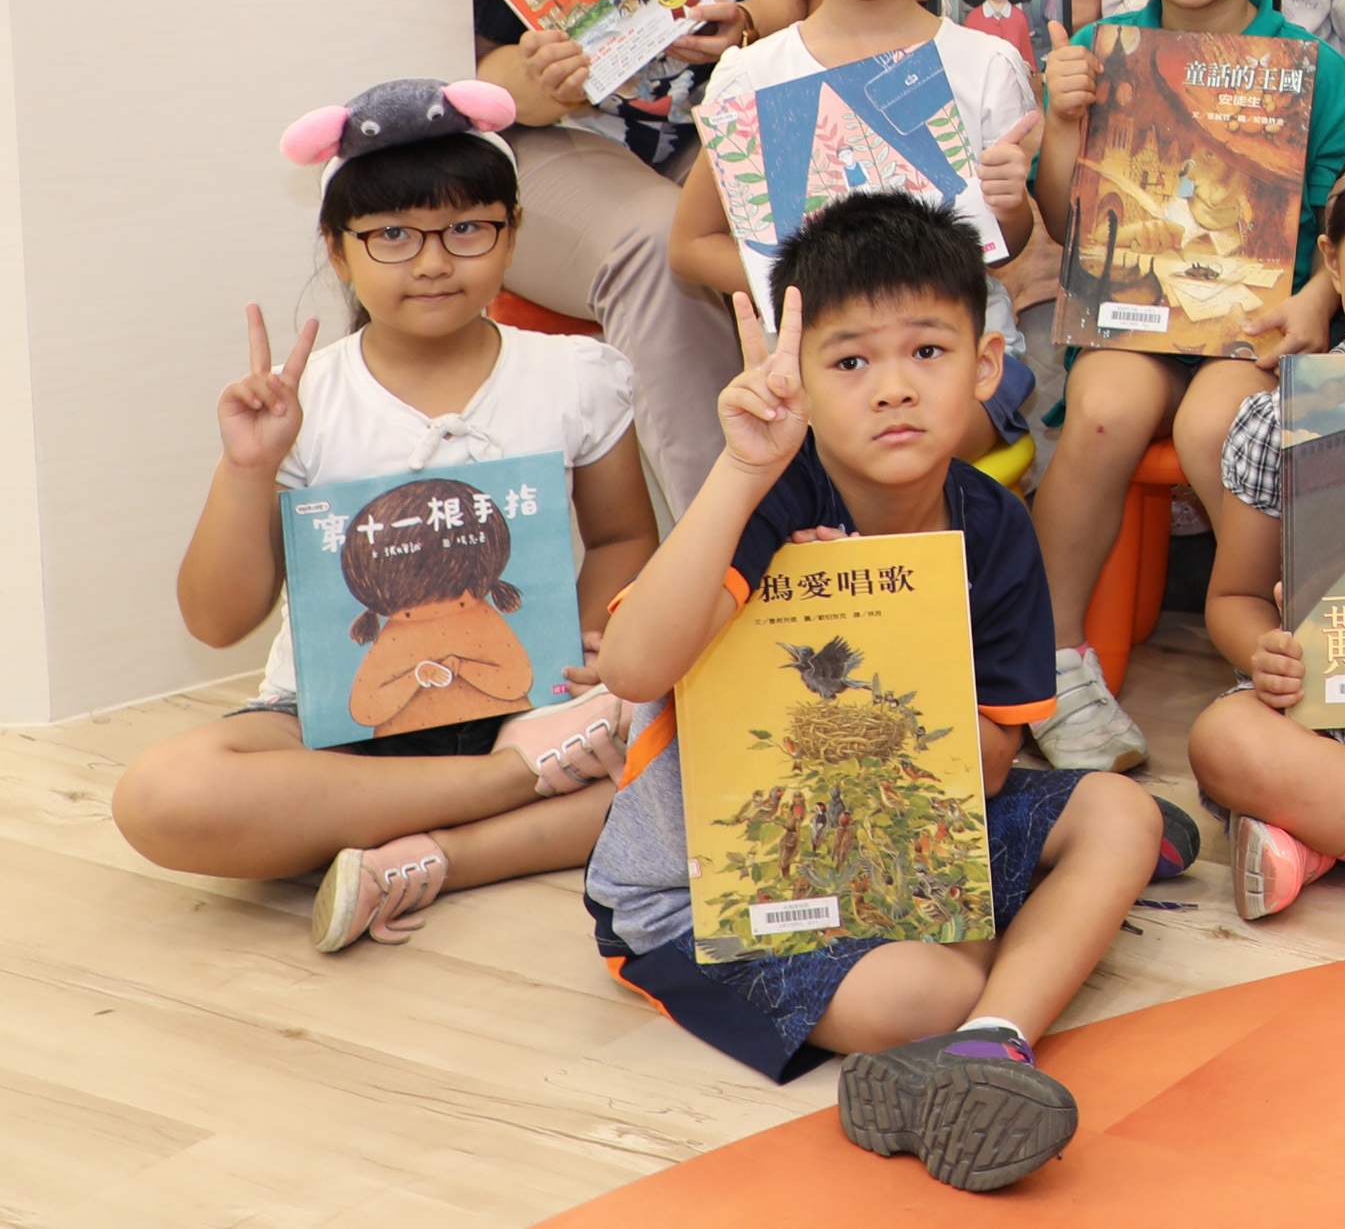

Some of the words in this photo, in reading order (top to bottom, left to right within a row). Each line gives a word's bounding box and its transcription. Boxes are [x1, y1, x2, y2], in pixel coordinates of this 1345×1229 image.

[1182, 60, 1304, 94] 童話的王國
[1219, 94, 1262, 108] 安徒生
[313, 483, 538, 553] 第十一根手指
